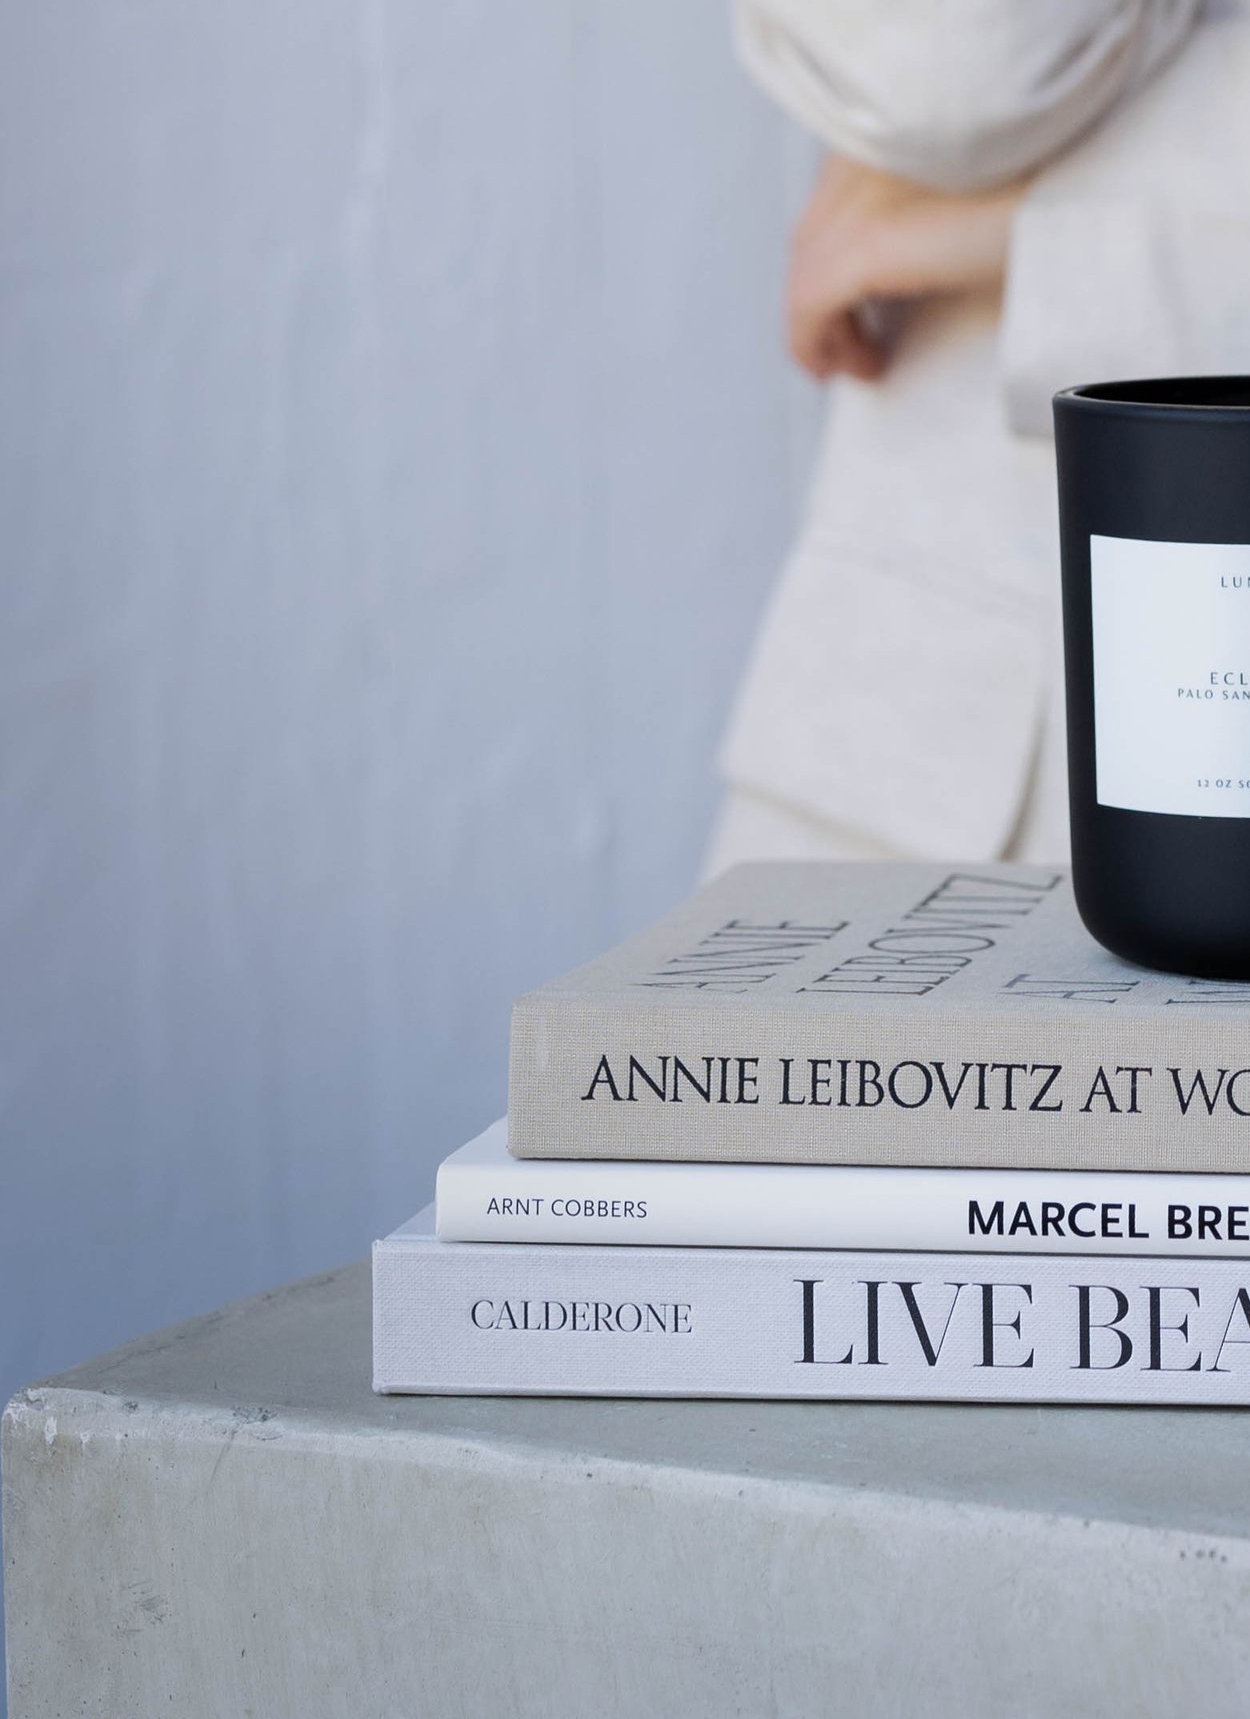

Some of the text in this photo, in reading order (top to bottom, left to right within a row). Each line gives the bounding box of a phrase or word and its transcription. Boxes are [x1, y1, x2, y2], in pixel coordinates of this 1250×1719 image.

[1177, 687, 1214, 699] PALO
[1215, 779, 1232, 788] OZ
[796, 873, 1064, 996] LEIBOVITZ
[580, 1054, 760, 1106] ANNIE
[778, 1058, 1064, 1113] LEIBOVITZ
[1078, 1065, 1153, 1115] AT
[486, 1197, 648, 1219] ARNT COBBERS
[968, 1200, 1150, 1239] MARCEL
[470, 1299, 693, 1334] CALDERONE
[793, 1279, 1036, 1370] LIVE
